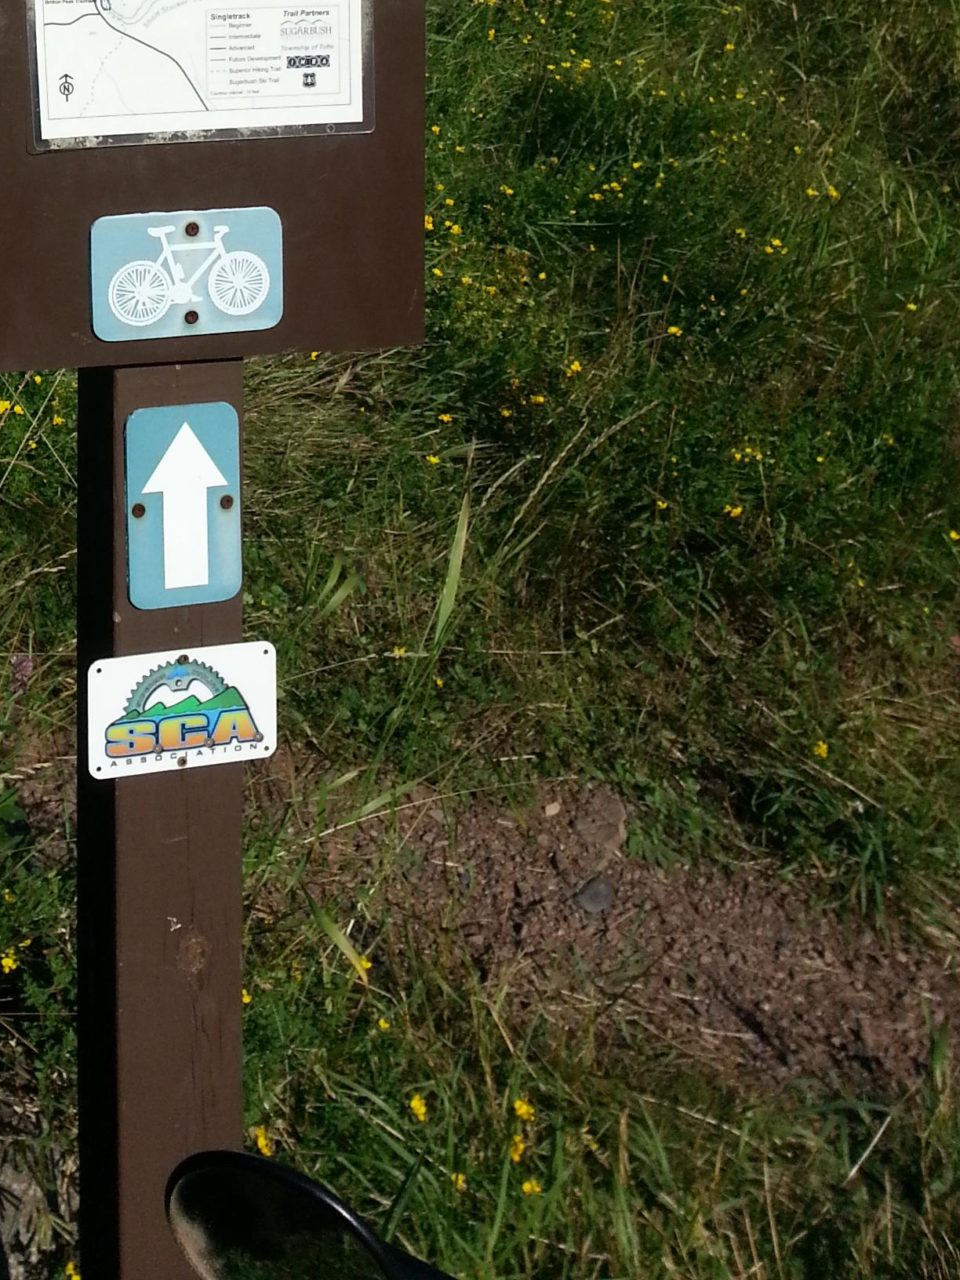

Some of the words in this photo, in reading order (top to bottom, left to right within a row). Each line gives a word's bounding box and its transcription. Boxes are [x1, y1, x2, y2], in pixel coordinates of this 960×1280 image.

[210, 13, 250, 21] Singletrack
[300, 9, 330, 17] Partners
[280, 26, 332, 35] SUGARBUSH
[105, 707, 260, 759] SCA
[110, 743, 258, 768] ASSOCIATION
